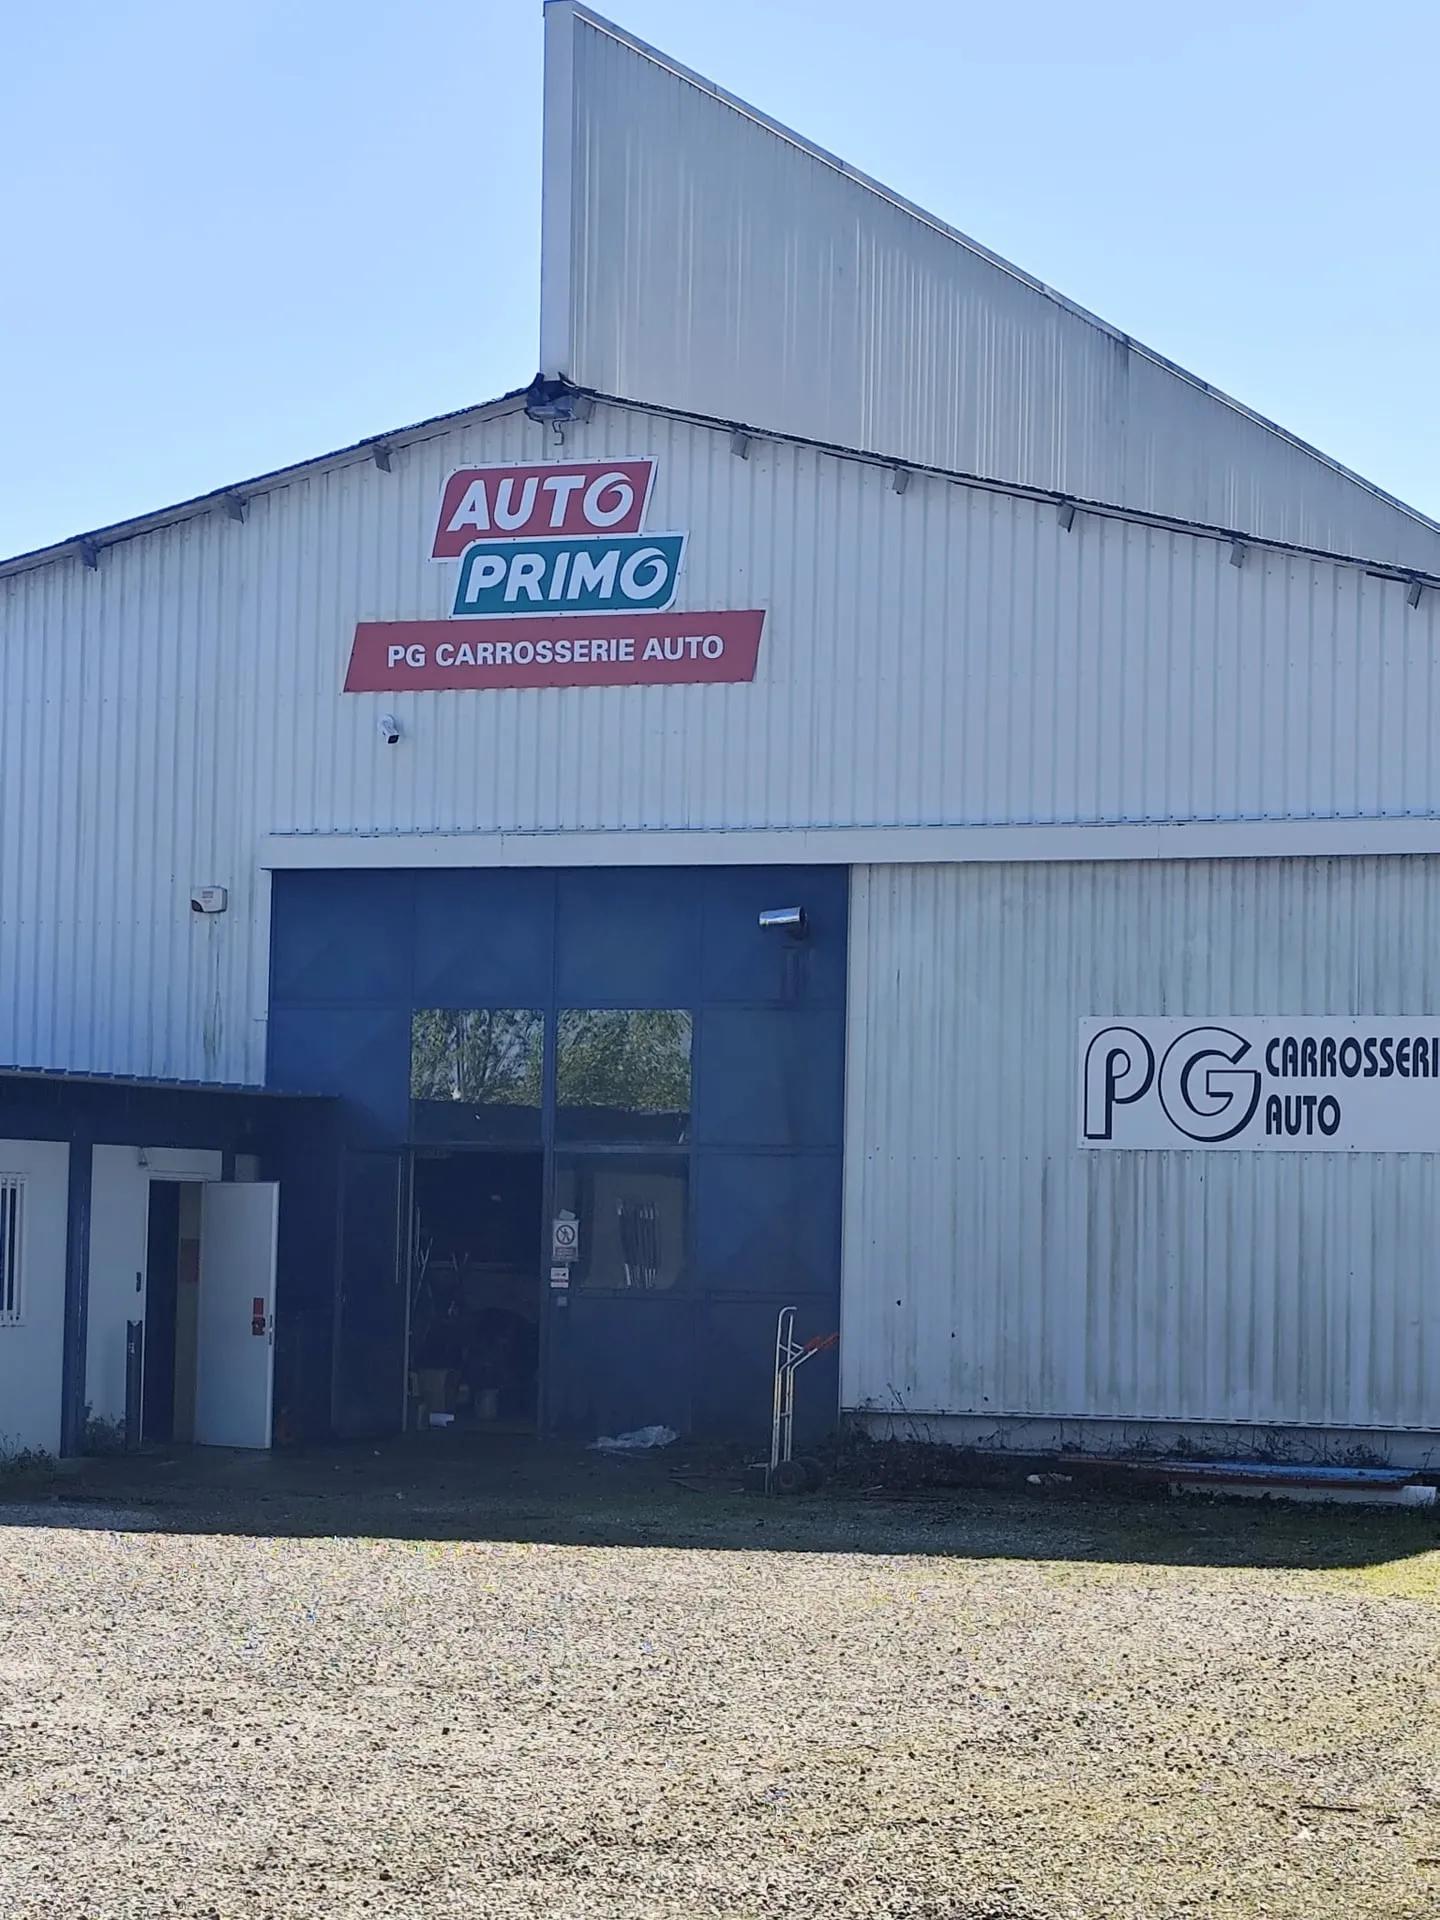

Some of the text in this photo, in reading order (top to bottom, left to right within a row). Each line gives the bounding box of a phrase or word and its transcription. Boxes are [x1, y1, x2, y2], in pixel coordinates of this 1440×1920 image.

[445, 471, 634, 532] AUTO
[464, 546, 669, 604] PRIMO
[387, 634, 725, 668] PG CARROSSERIE AUTO
[1083, 1026, 1262, 1143] PG
[1265, 1094, 1341, 1136] AUTO
